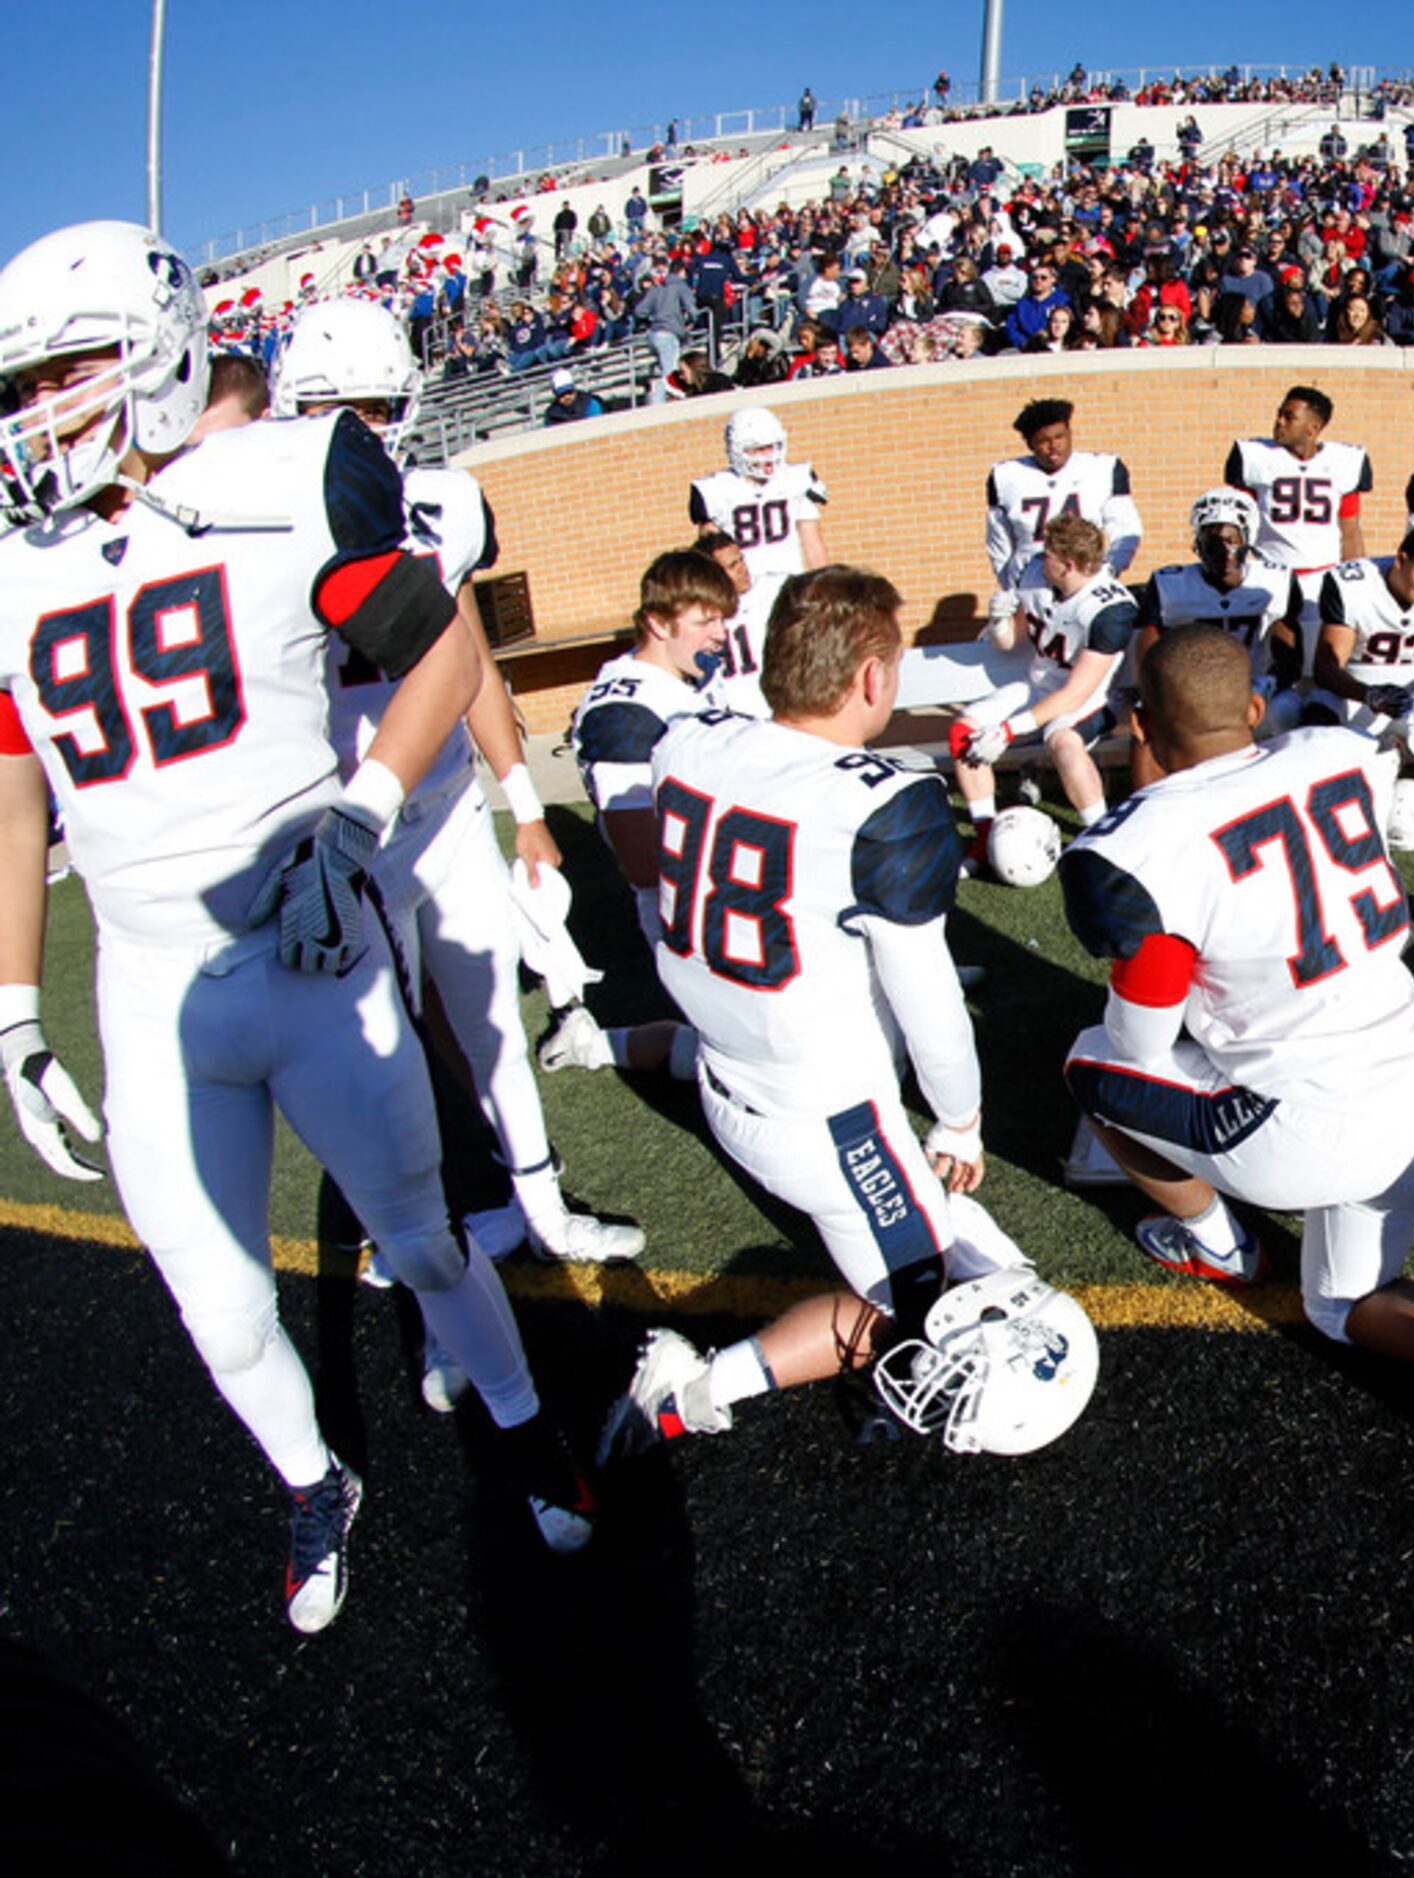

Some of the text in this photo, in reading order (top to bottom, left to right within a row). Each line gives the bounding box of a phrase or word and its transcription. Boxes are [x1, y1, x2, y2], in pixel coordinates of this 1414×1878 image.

[731, 498, 790, 550] 80
[1271, 477, 1333, 525] 95
[28, 561, 249, 791] 99
[656, 774, 803, 993] 98
[1208, 766, 1411, 991] 79
[846, 1138, 908, 1229] EAGLES
